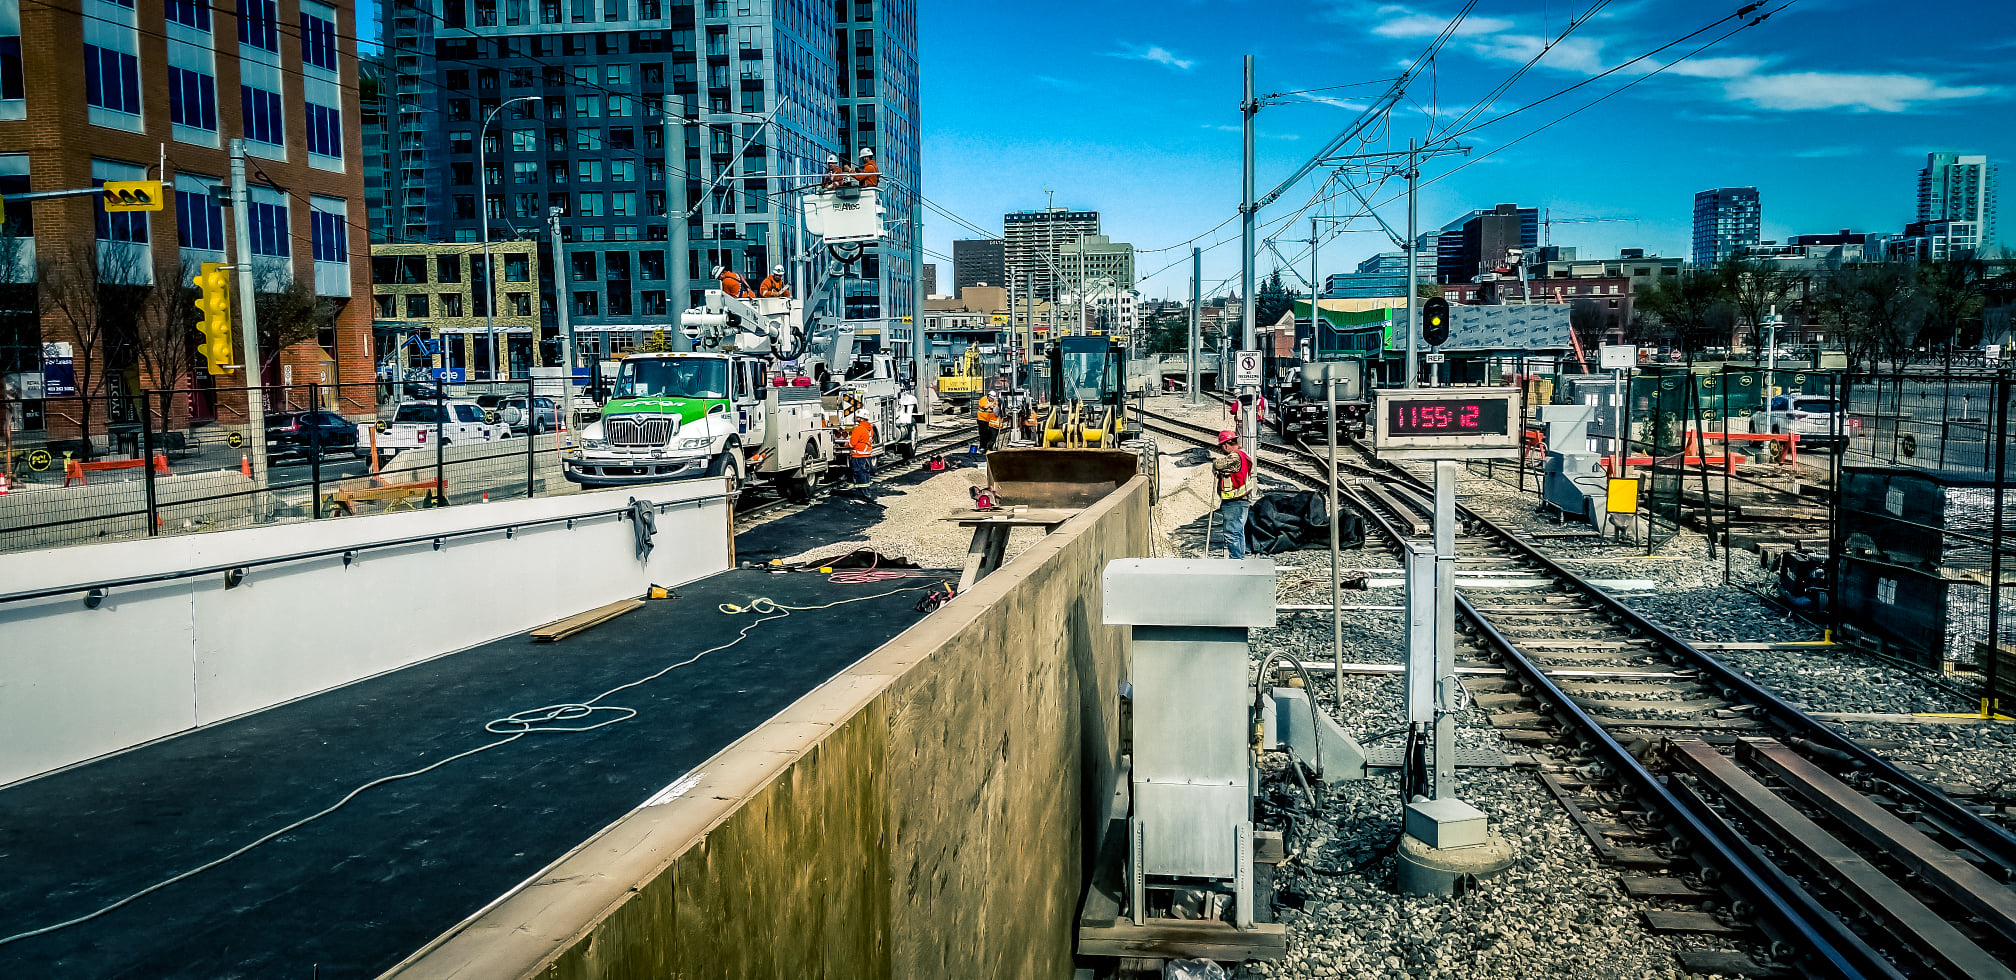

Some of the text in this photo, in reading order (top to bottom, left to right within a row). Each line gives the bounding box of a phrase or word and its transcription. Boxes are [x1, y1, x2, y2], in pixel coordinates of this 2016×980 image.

[842, 202, 860, 211] Altec
[110, 379, 120, 417] JYOTI
[31, 454, 48, 465] PCL
